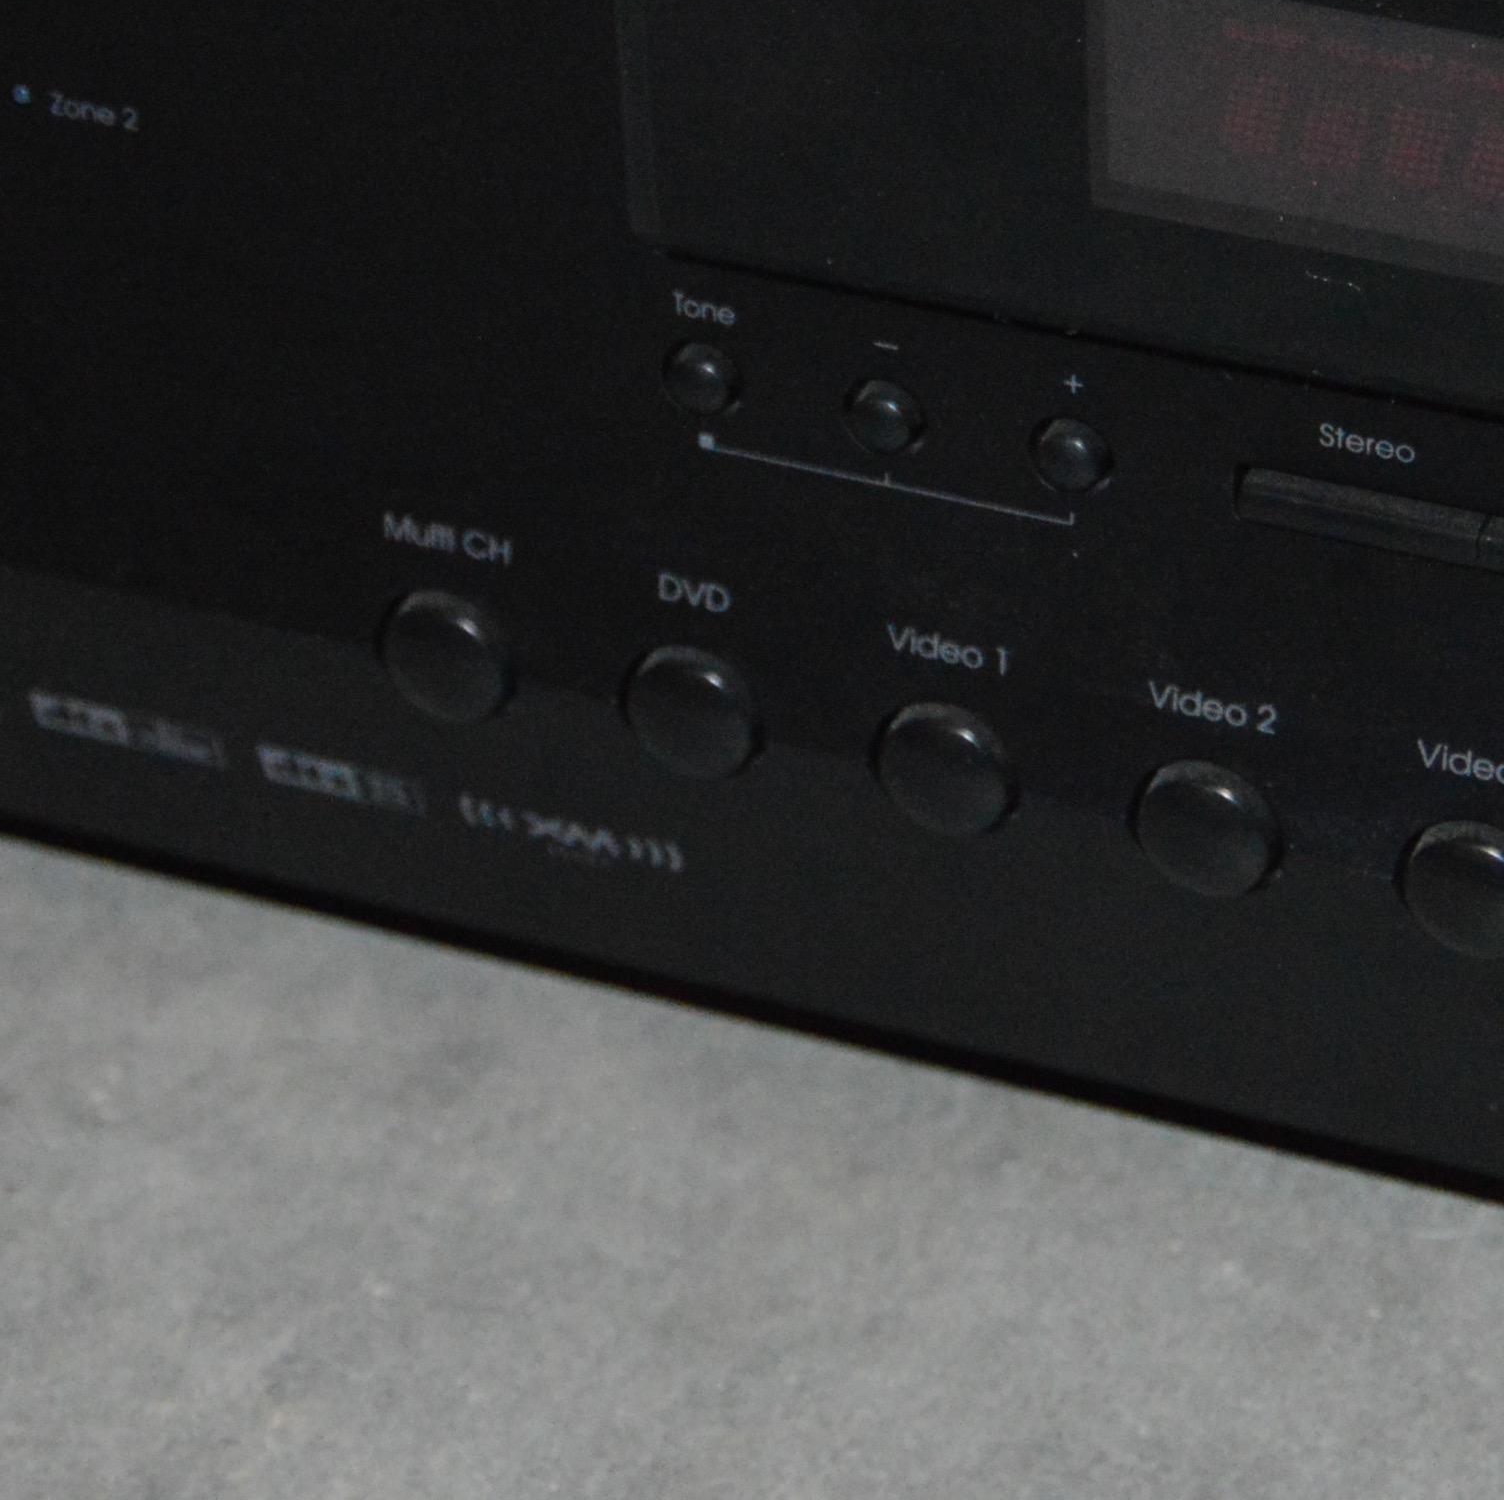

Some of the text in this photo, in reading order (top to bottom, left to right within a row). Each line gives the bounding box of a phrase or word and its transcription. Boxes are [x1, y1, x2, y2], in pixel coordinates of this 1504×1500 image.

[672, 289, 737, 327] Tone
[1318, 422, 1417, 464] Stereo
[462, 529, 514, 566] CH
[658, 572, 732, 613] DVD
[886, 623, 1009, 677] Video 1
[1148, 680, 1279, 736] Video 2
